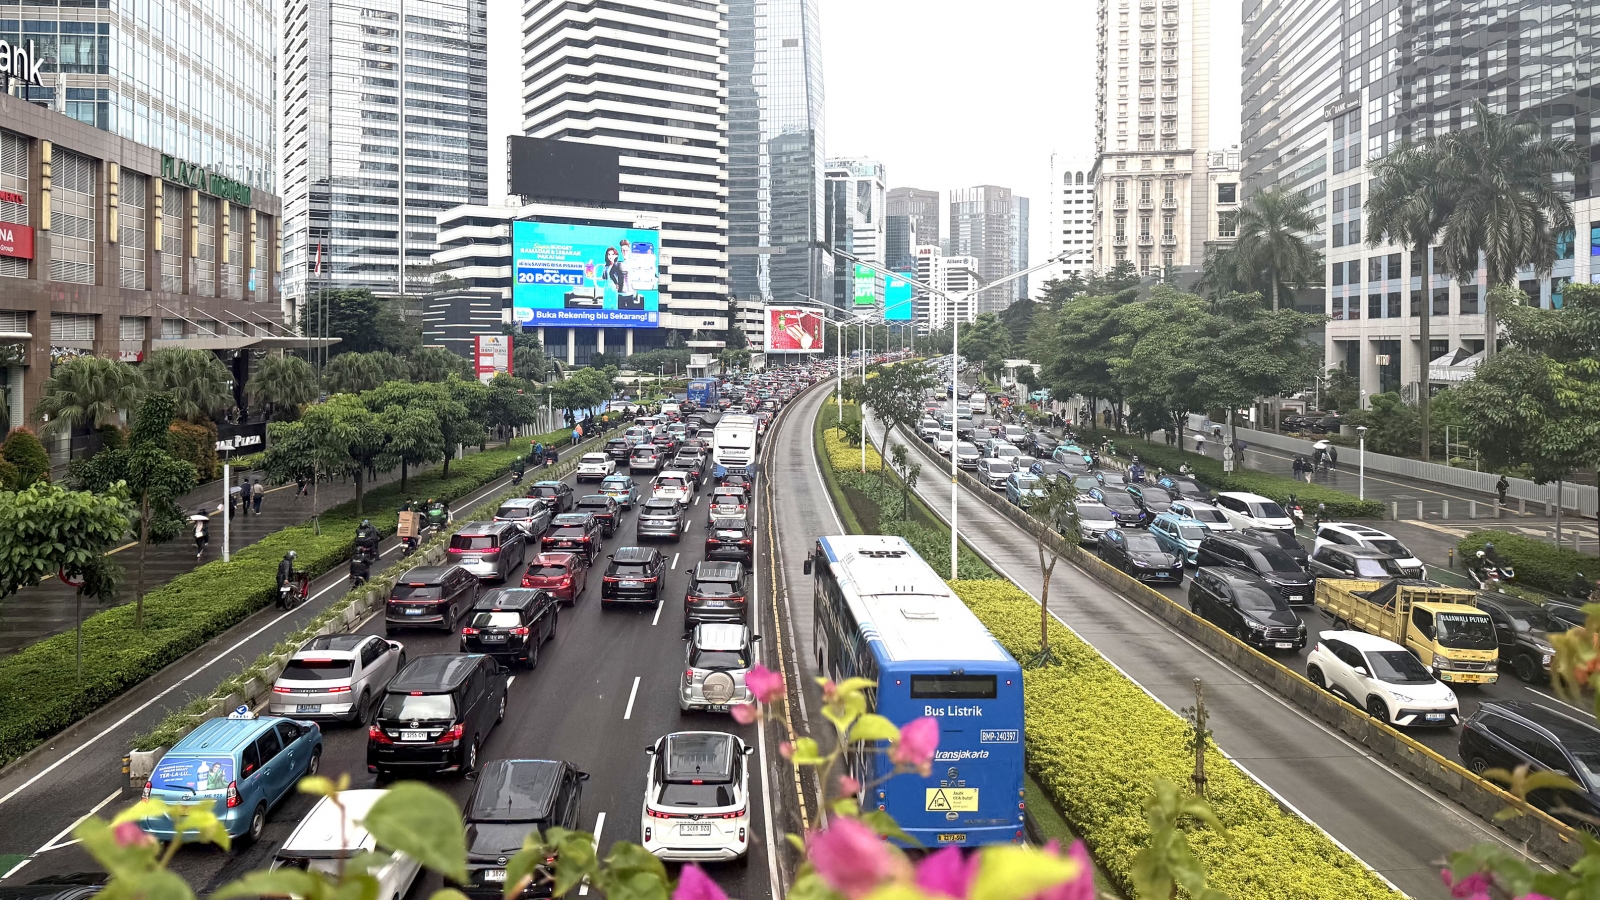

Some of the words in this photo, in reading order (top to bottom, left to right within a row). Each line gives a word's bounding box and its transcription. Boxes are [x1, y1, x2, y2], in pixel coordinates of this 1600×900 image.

[1334, 102, 1346, 114] BANK
[161, 153, 208, 191] PLAZA
[518, 272, 535, 283] 20
[535, 273, 583, 284] POCKET
[536, 310, 557, 319] Buka
[558, 311, 595, 321] Rekening
[596, 312, 609, 320] blu
[609, 313, 648, 321] Sekarang!
[234, 435, 262, 447] PLAZA
[1440, 614, 1469, 622] RAJAWALI
[924, 705, 945, 716] Bus
[947, 705, 982, 717] Listrik
[982, 731, 1016, 741] BMP-240397
[935, 750, 989, 762] transjakarta
